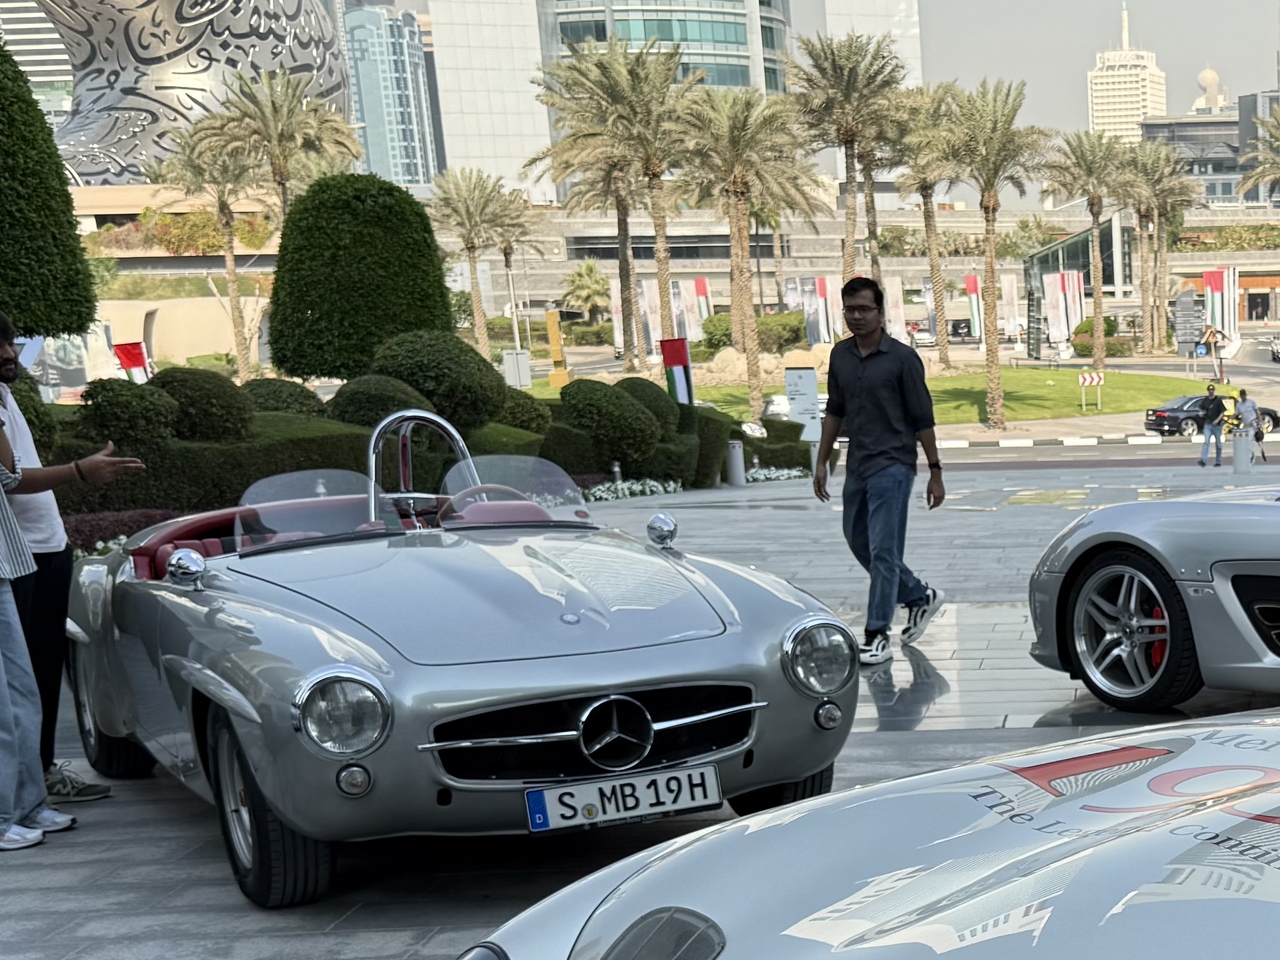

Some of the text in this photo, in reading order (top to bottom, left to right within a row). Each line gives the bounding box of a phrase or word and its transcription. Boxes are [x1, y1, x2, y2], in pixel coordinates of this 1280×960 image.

[535, 814, 543, 824] D
[558, 791, 578, 820] S
[598, 782, 640, 815] MB
[968, 785, 1034, 825] The
